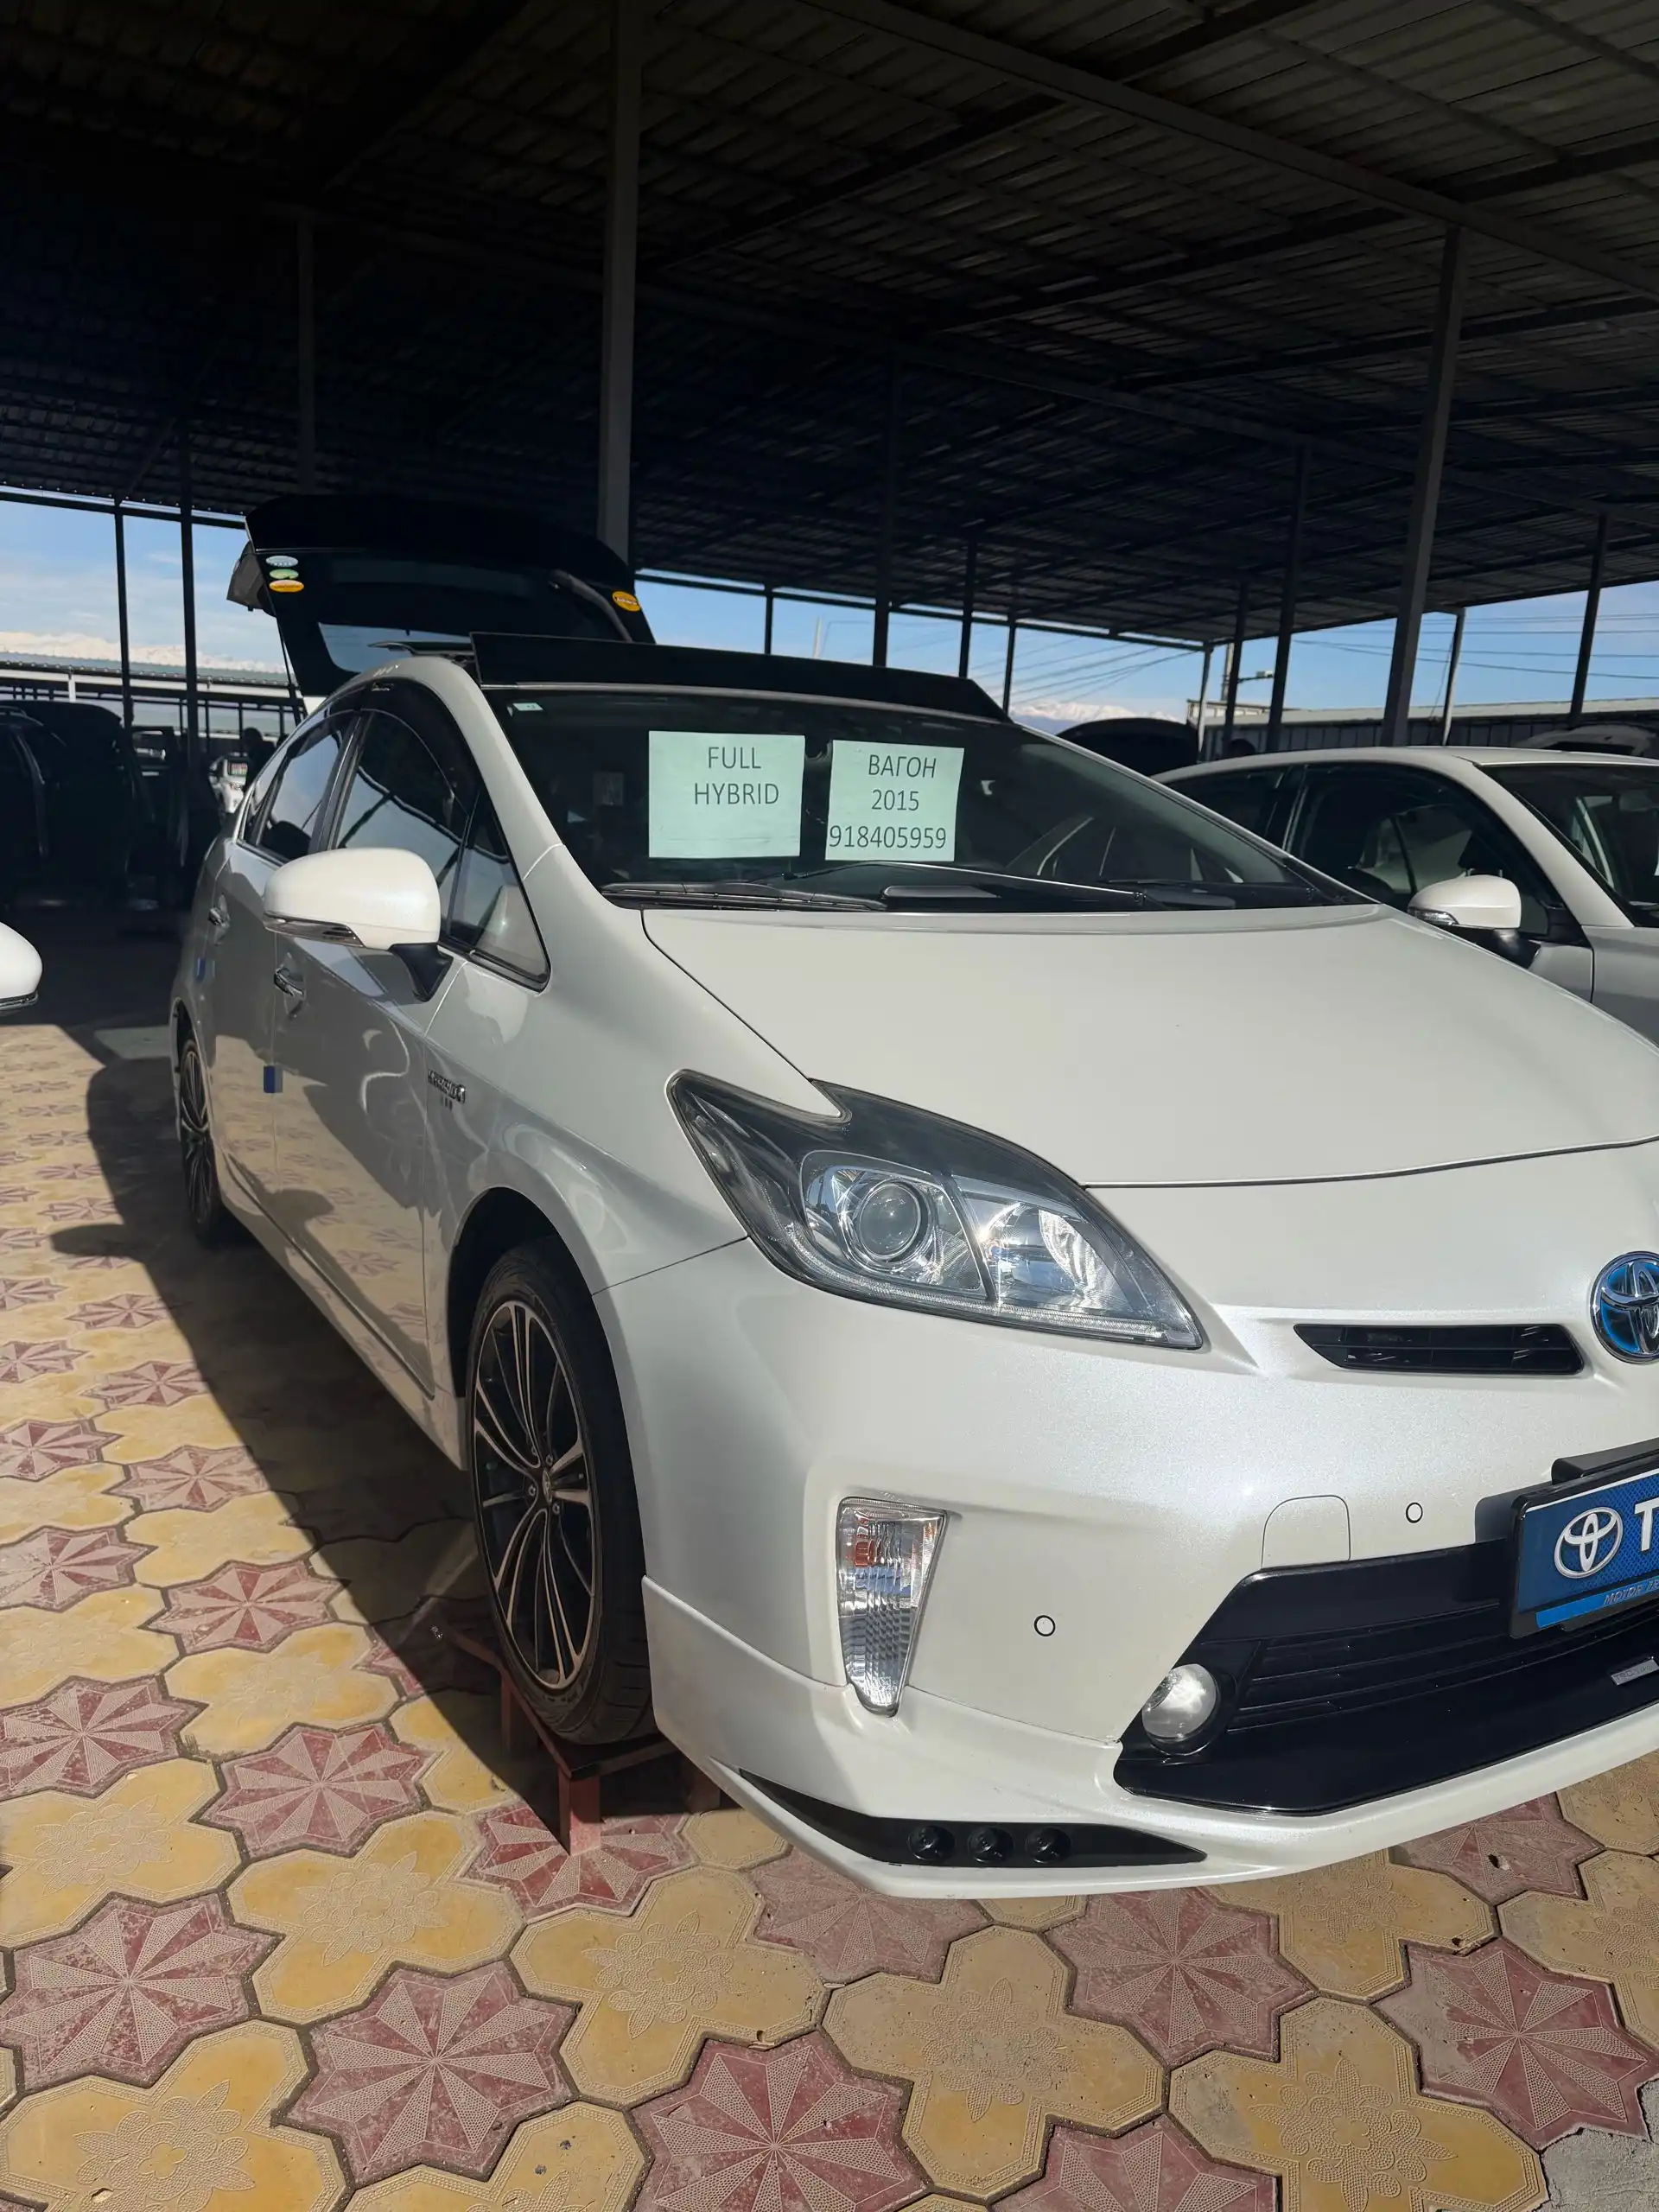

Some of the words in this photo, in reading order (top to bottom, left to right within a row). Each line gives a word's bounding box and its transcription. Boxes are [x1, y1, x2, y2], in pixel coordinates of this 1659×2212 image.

[708, 746, 762, 769] FULL
[868, 753, 937, 779] ВАГОН
[694, 782, 779, 805] HYBRID
[871, 789, 919, 811] 2015
[828, 825, 947, 849] 918405959
